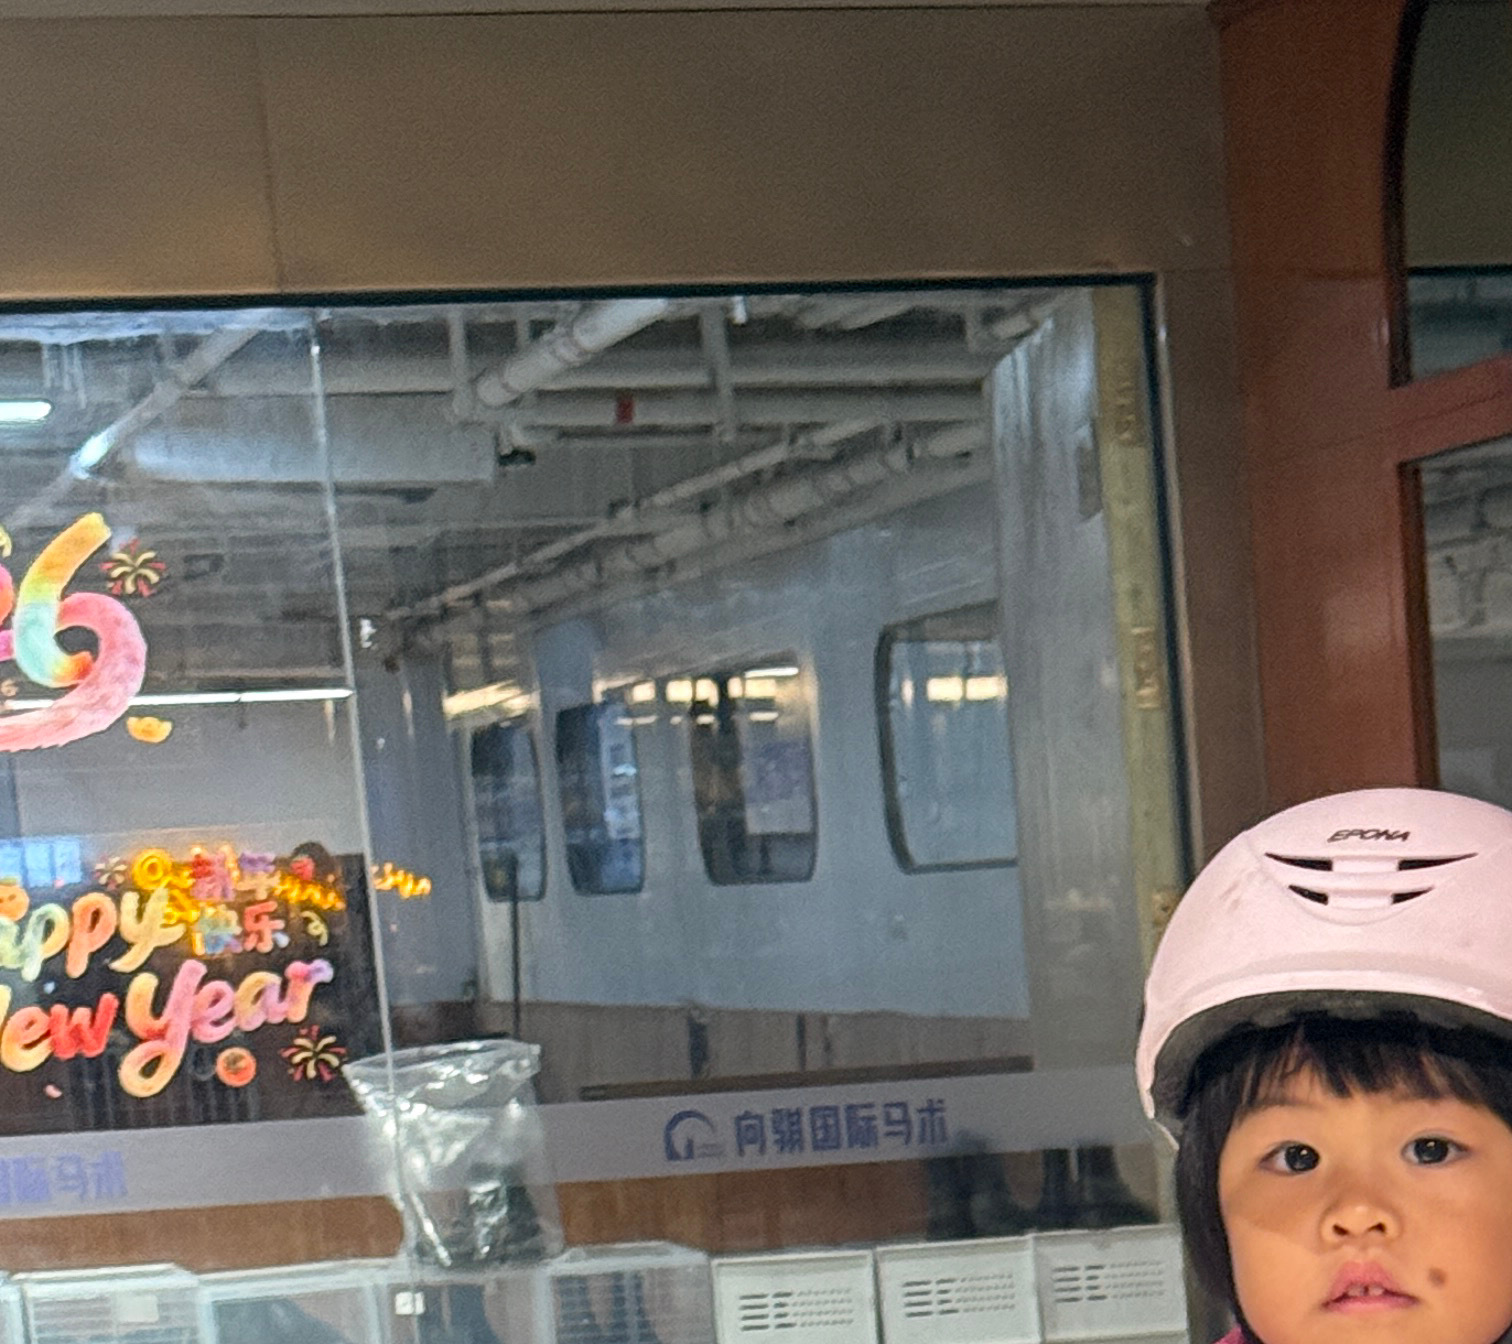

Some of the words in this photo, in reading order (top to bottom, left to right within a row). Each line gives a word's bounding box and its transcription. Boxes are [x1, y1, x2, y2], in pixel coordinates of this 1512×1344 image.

[0, 512, 148, 752] 6
[0, 984, 119, 1073] ew
[118, 958, 335, 1098] Year
